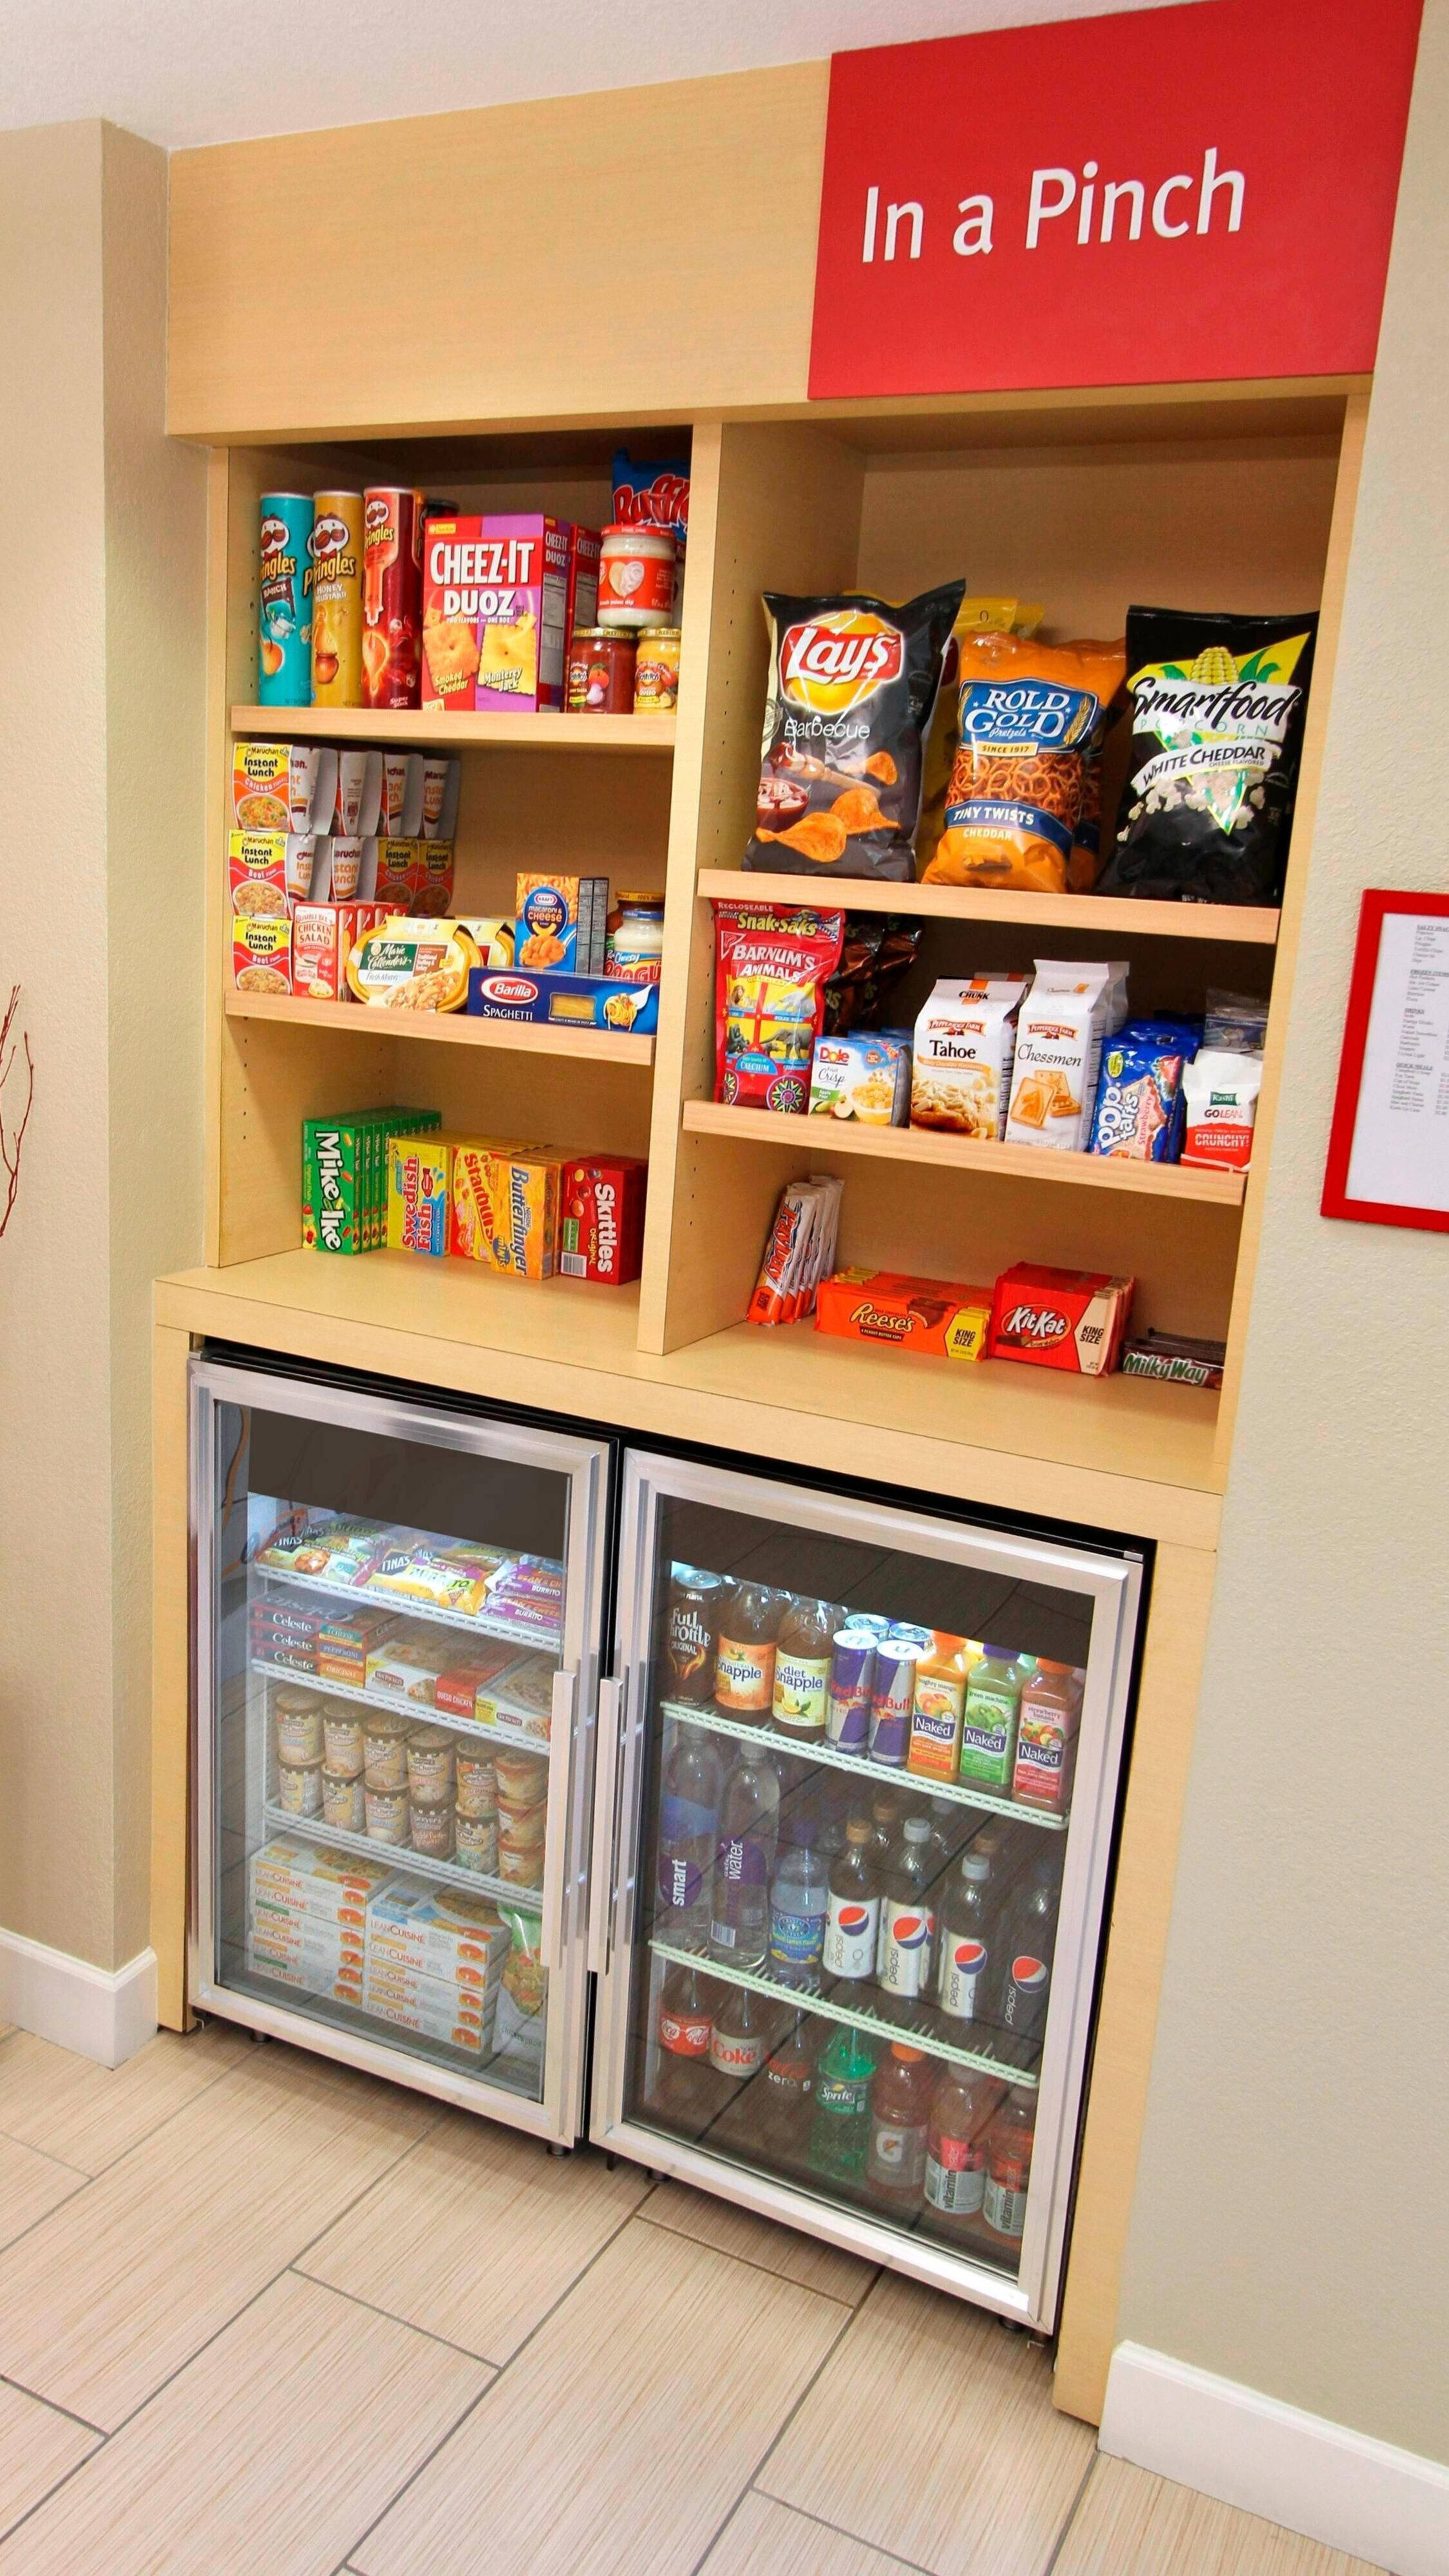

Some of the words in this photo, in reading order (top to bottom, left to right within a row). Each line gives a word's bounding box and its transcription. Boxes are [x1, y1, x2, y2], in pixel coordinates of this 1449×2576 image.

[862, 186, 925, 263] In
[951, 194, 994, 258] a
[1025, 146, 1246, 249] Pinch
[545, 531, 569, 552] CHEEZ-IT
[430, 540, 535, 585] CHEEZ-IT
[545, 551, 566, 567] DUOZ
[263, 582, 287, 599] RANCH
[315, 591, 346, 603] MUSTARD
[316, 583, 344, 594] HONEY
[443, 589, 516, 617] DUOZ
[785, 625, 896, 685] Lay's
[434, 670, 463, 687] Smoked
[483, 667, 523, 685] Monterey
[438, 679, 469, 696] Cheddar
[498, 678, 519, 692] Jack
[982, 688, 1070, 711] ROLD
[1132, 676, 1302, 729] Smartfood
[784, 715, 871, 741] Barbecue
[965, 708, 1066, 739] GOLD
[989, 726, 1027, 740] Pretzels
[248, 746, 279, 757] Maruchan
[981, 744, 1006, 754] SINCE
[1009, 746, 1030, 754] 1917
[244, 757, 279, 768] Instant
[1142, 757, 1188, 786] WHITE
[1189, 744, 1265, 768] CHEDDAR
[247, 766, 275, 778] Lunch
[244, 777, 273, 792] Chicken
[952, 807, 982, 823] TINY
[983, 806, 1035, 826] TWISTS
[242, 836, 272, 846] Maruchan
[962, 828, 1012, 841] CHEDDAR
[240, 846, 270, 856] Instant
[243, 853, 267, 863] Lunch
[386, 849, 412, 860] Instant
[426, 851, 449, 862] Instant
[247, 866, 263, 877] Beef
[388, 858, 408, 868] Lunch
[428, 860, 446, 871] Lunch
[527, 905, 558, 914] macaroni
[717, 901, 774, 912] RECLOSEABLE
[247, 922, 279, 932] Maruchan
[298, 922, 332, 936] CHICKEN
[245, 931, 278, 943] Instant
[249, 940, 274, 951] Lunch
[299, 934, 331, 945] SALAD
[380, 943, 406, 958] Marie
[614, 952, 640, 963] Cheesy
[732, 944, 816, 971] BARNUM'S
[252, 954, 269, 965] Beef
[367, 955, 412, 971] Callender's
[739, 963, 804, 983] ANIMALS
[494, 982, 532, 998] Barilla
[958, 990, 990, 1000] CHUNK
[483, 1003, 533, 1021] SPAGHETTI
[931, 1019, 965, 1029] PEPPERIDGE
[965, 1022, 981, 1031] FARM
[1030, 1025, 1059, 1033] PEPPERIDGE
[1058, 1028, 1074, 1037] FARM
[819, 1046, 850, 1063] Dole
[929, 1039, 978, 1060] Tahoe
[1018, 1043, 1083, 1067] Chessmen
[740, 1061, 770, 1072] CALCIUM
[818, 1067, 846, 1089] Crisp
[1138, 1095, 1155, 1146] Strawberry
[1195, 1133, 1250, 1148] CRUNCHY!
[315, 1131, 345, 1201] Mike
[402, 1156, 419, 1249] Swedish
[464, 1152, 494, 1245] Starburs
[417, 1202, 433, 1252] Fish
[509, 1165, 529, 1276] Butterfinger
[594, 1182, 618, 1273] Skittles
[319, 1209, 346, 1251] Ike
[849, 1302, 916, 1333] Reese's
[955, 1328, 976, 1340] KING
[1079, 1333, 1103, 1345] SIZE
[1082, 1325, 1104, 1337] KING
[952, 1336, 973, 1348] SIZE
[531, 1585, 562, 1597] BURRITO
[272, 1612, 312, 1633] Celeste
[514, 1608, 544, 1622] BURRITO
[272, 1632, 313, 1651] Celeste
[323, 1645, 359, 1659] PEPPERONI
[274, 1651, 314, 1672] Celeste
[775, 1665, 824, 1692] Snapple
[784, 1665, 806, 1678] diet
[452, 1695, 473, 1708] CHICKEN
[885, 1696, 911, 1710] Bull
[1027, 1705, 1061, 1720] strawberry
[1032, 1712, 1055, 1722] banana
[915, 1716, 951, 1737] Naked
[965, 1729, 1002, 1750] Naked
[1021, 1744, 1059, 1765] Naked
[727, 1840, 744, 1880] water
[672, 1859, 688, 1907] smart
[834, 1933, 845, 1969] pepsi
[889, 1946, 899, 1985] pepsi
[949, 1972, 960, 2009] pepsi
[1004, 1984, 1017, 2027] pepsi
[712, 2040, 758, 2065] Coke
[768, 2070, 797, 2087] zero
[821, 2085, 855, 2102] Sprite
[944, 2170, 957, 2209] vitamin
[1001, 2189, 1014, 2230] vitamin
